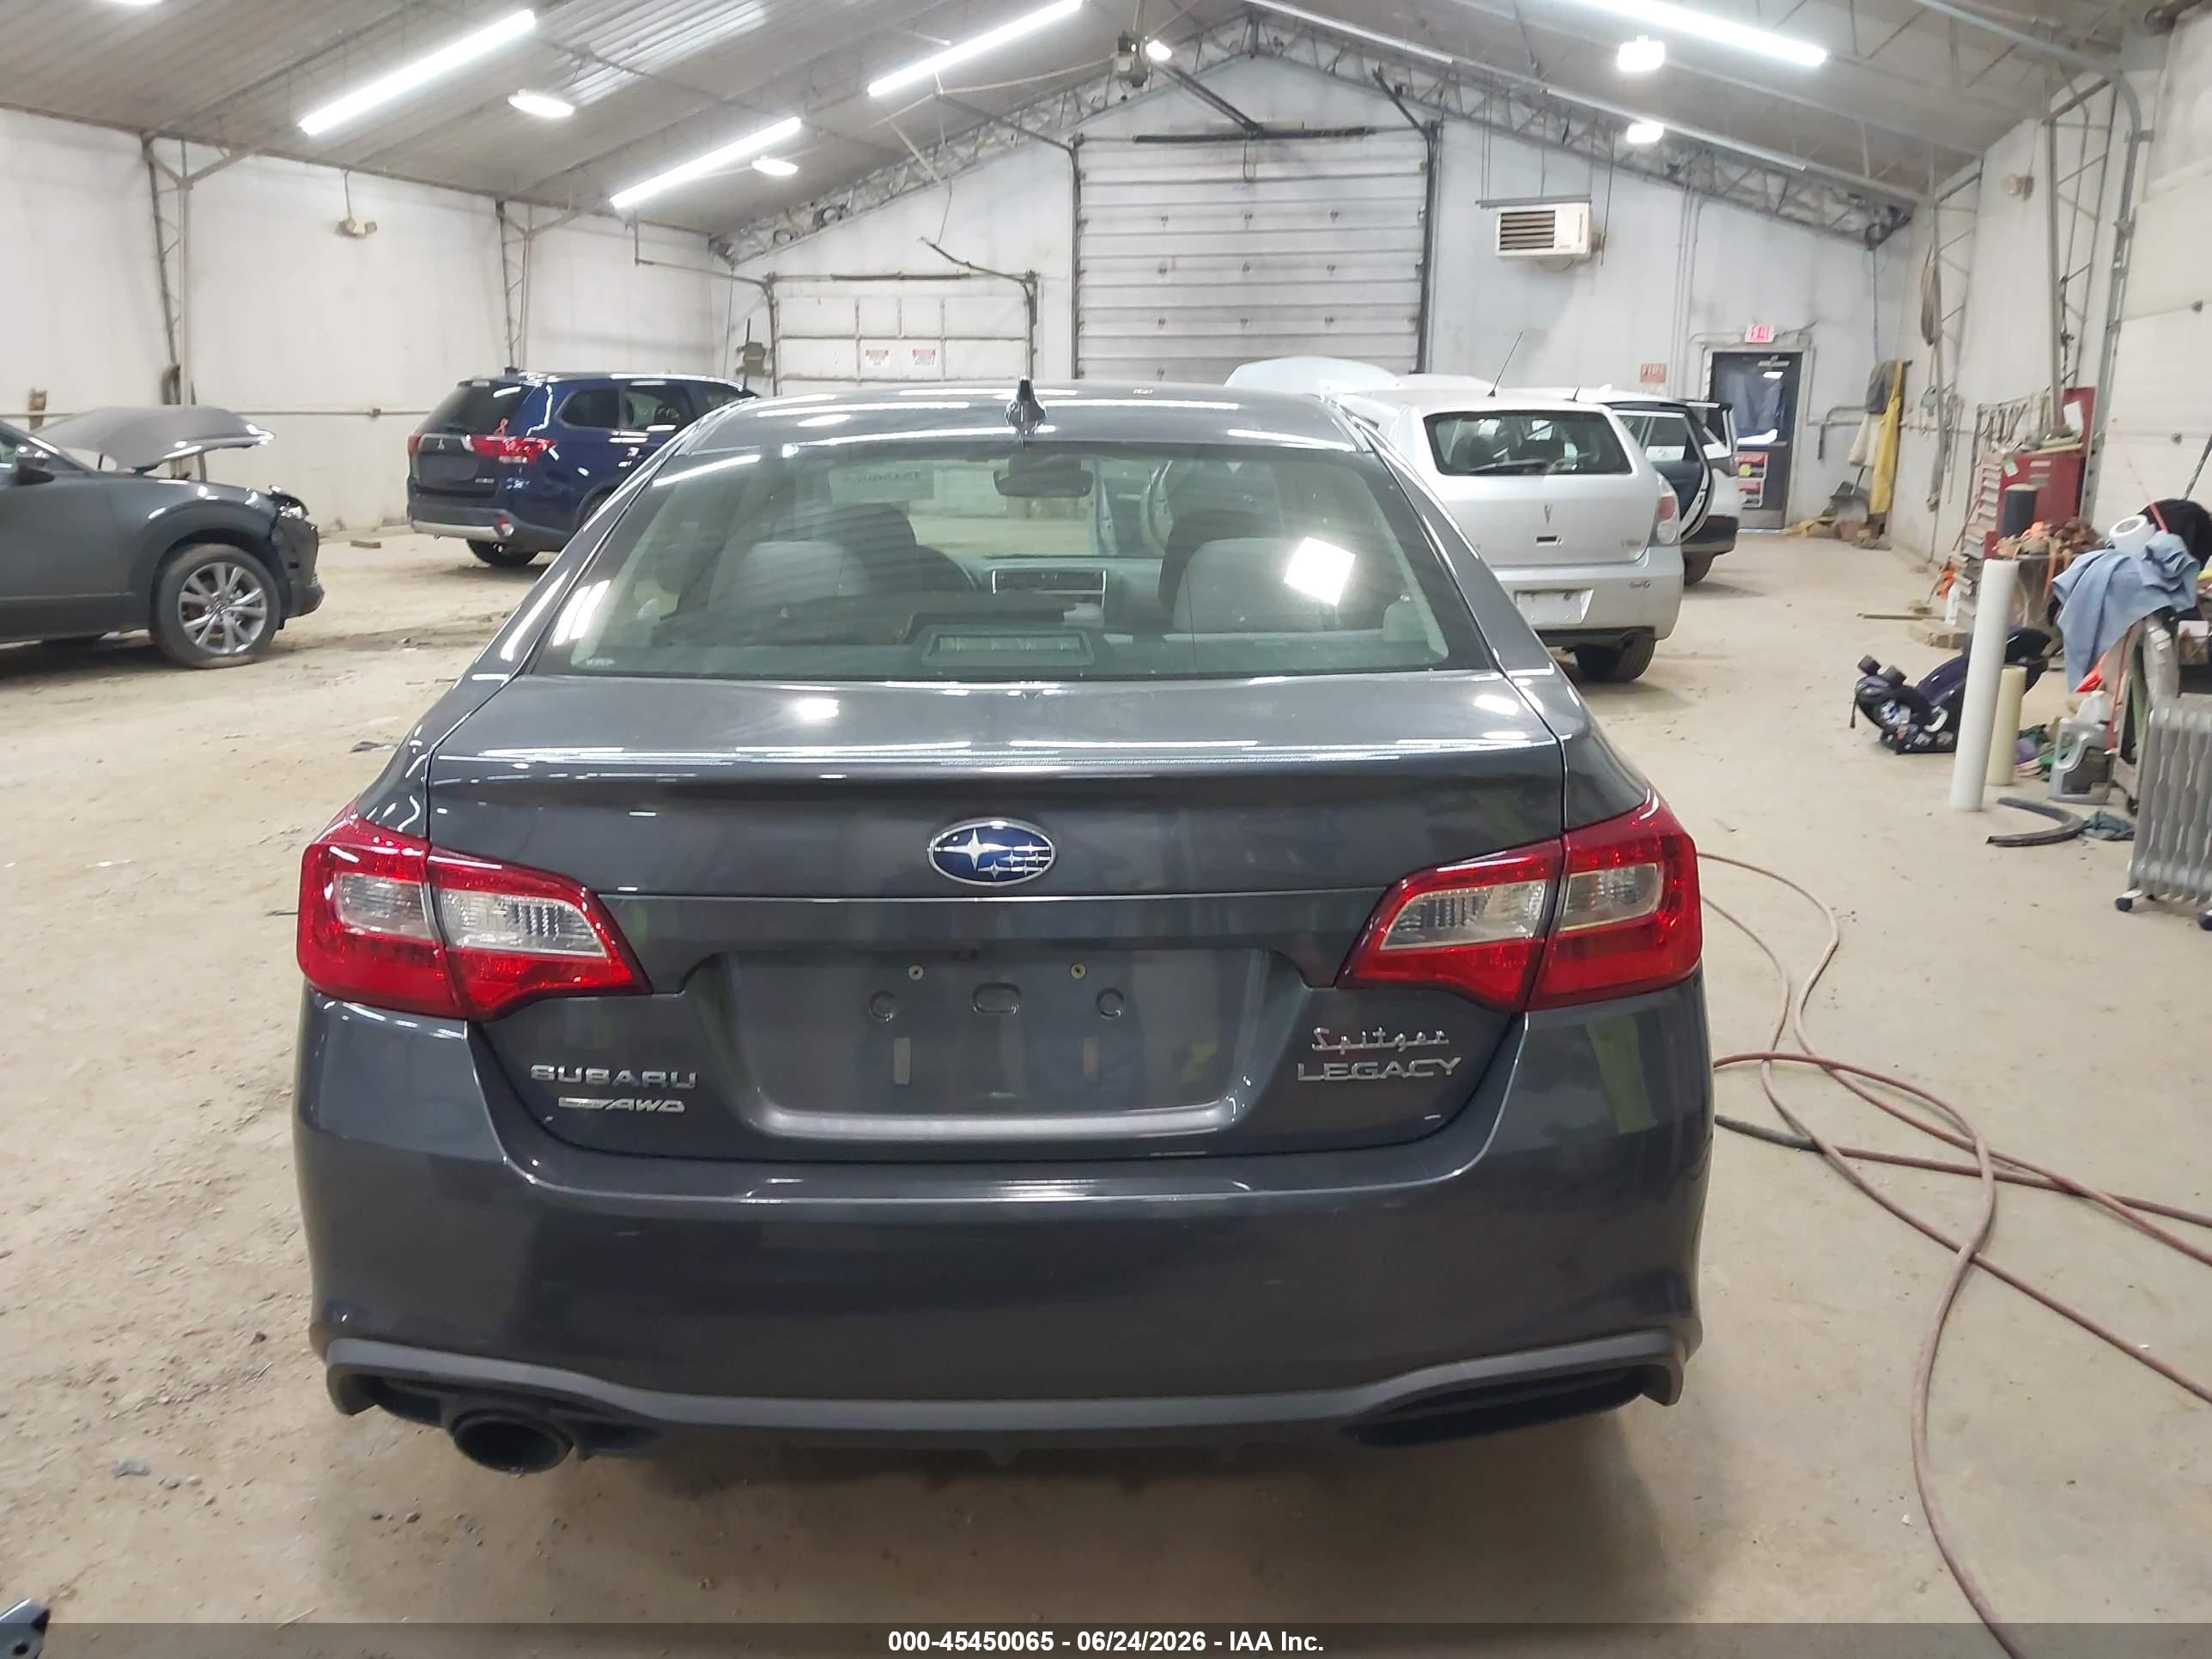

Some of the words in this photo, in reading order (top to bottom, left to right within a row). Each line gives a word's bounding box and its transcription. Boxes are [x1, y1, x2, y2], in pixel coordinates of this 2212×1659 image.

[530, 1064, 698, 1090] SUBARU
[1297, 1057, 1462, 1082] LEGACY
[605, 1098, 686, 1113] AWD
